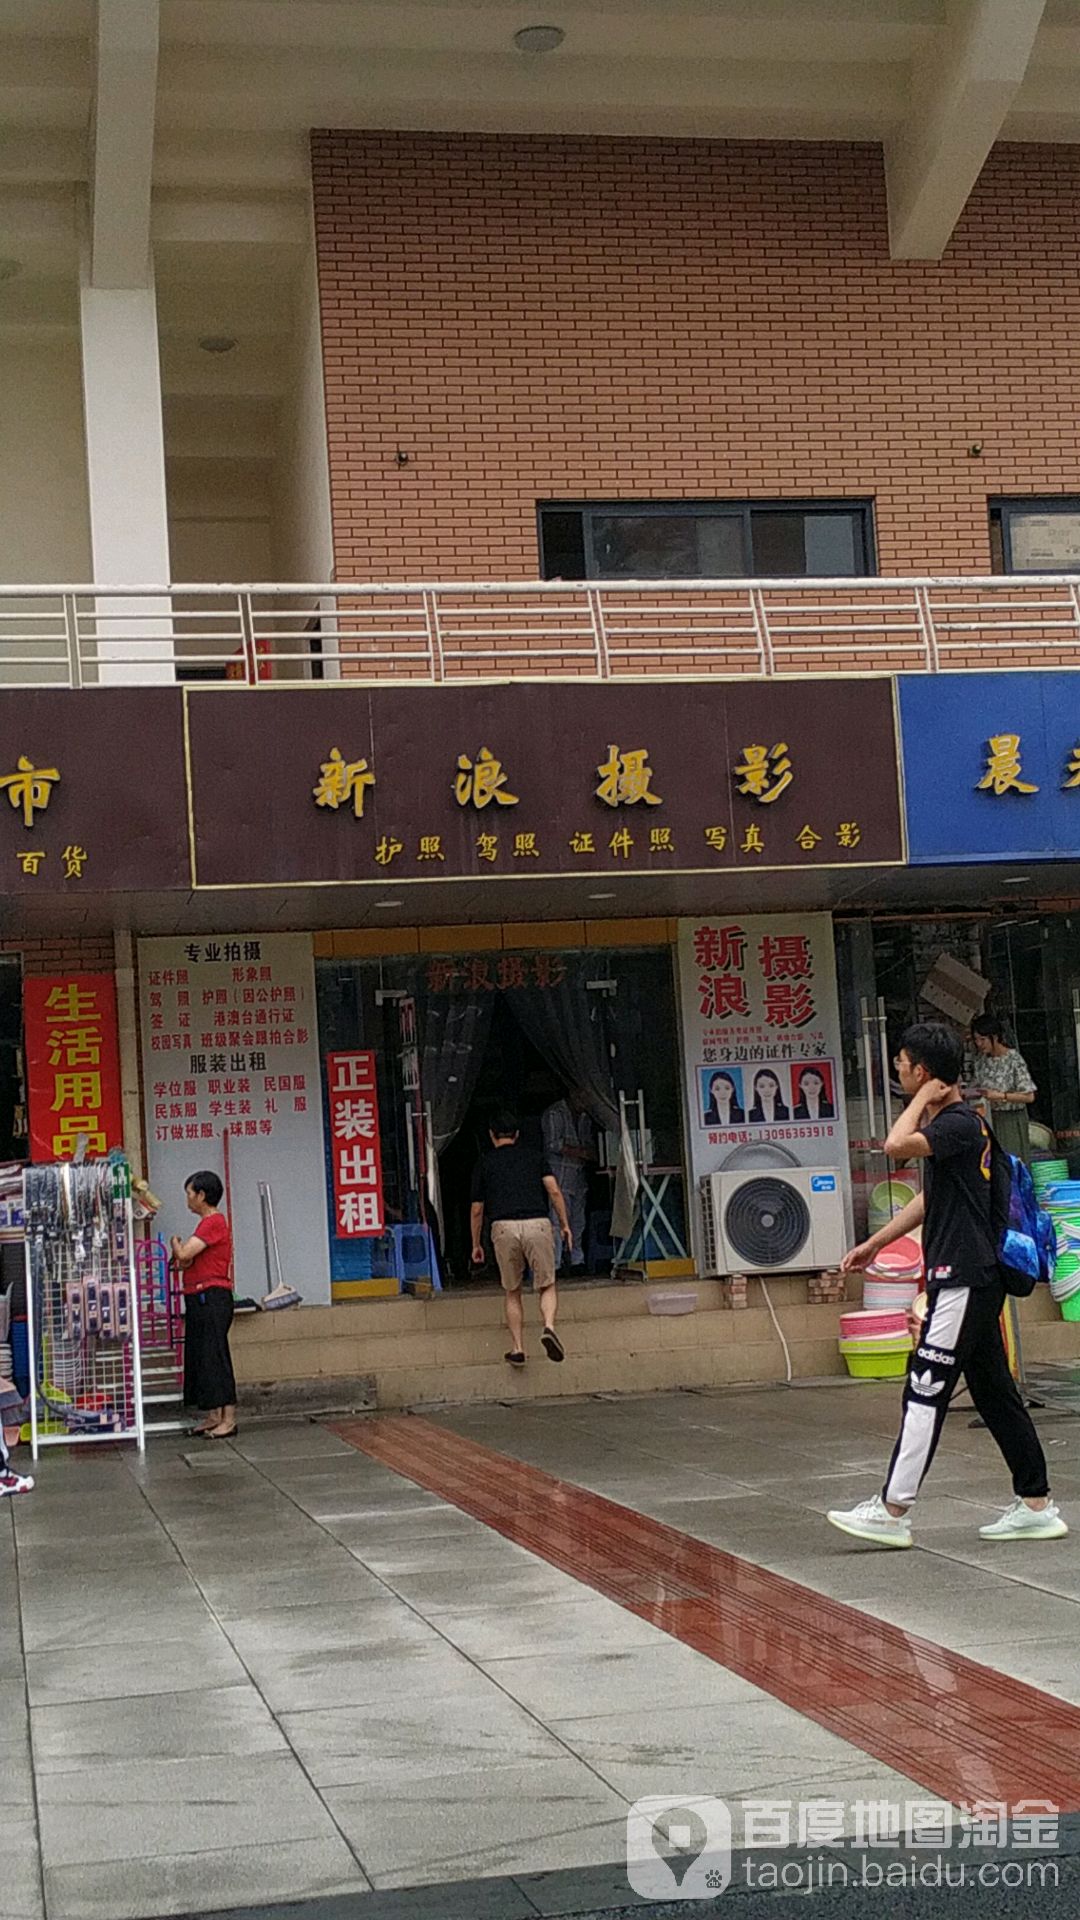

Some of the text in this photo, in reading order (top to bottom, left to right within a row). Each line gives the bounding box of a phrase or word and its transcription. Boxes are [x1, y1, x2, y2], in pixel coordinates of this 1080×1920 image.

[0, 756, 60, 827] 市
[312, 744, 794, 818] 新浪摄影
[375, 822, 863, 865] 护照 驾照 证件照 写真 合影
[16, 846, 88, 878] 百货
[184, 941, 262, 963] 专业拍摄
[148, 966, 273, 986] 证件照 形象照
[693, 925, 751, 1019] 新浪
[757, 935, 816, 1029] 摄影
[213, 1007, 296, 1026] 港澳台通行证
[151, 1033, 193, 1051] 校园写真
[702, 1040, 828, 1064] 您身边的证件专家
[45, 985, 109, 1156] 生活用品
[189, 1051, 268, 1075] 服装出租
[153, 1074, 307, 1098] 学位服 职业装 民国服
[154, 1101, 198, 1119] 民族服
[208, 1098, 253, 1116] 学生装
[331, 1055, 383, 1234] 正装出租
[917, 1347, 955, 1366] adidas
